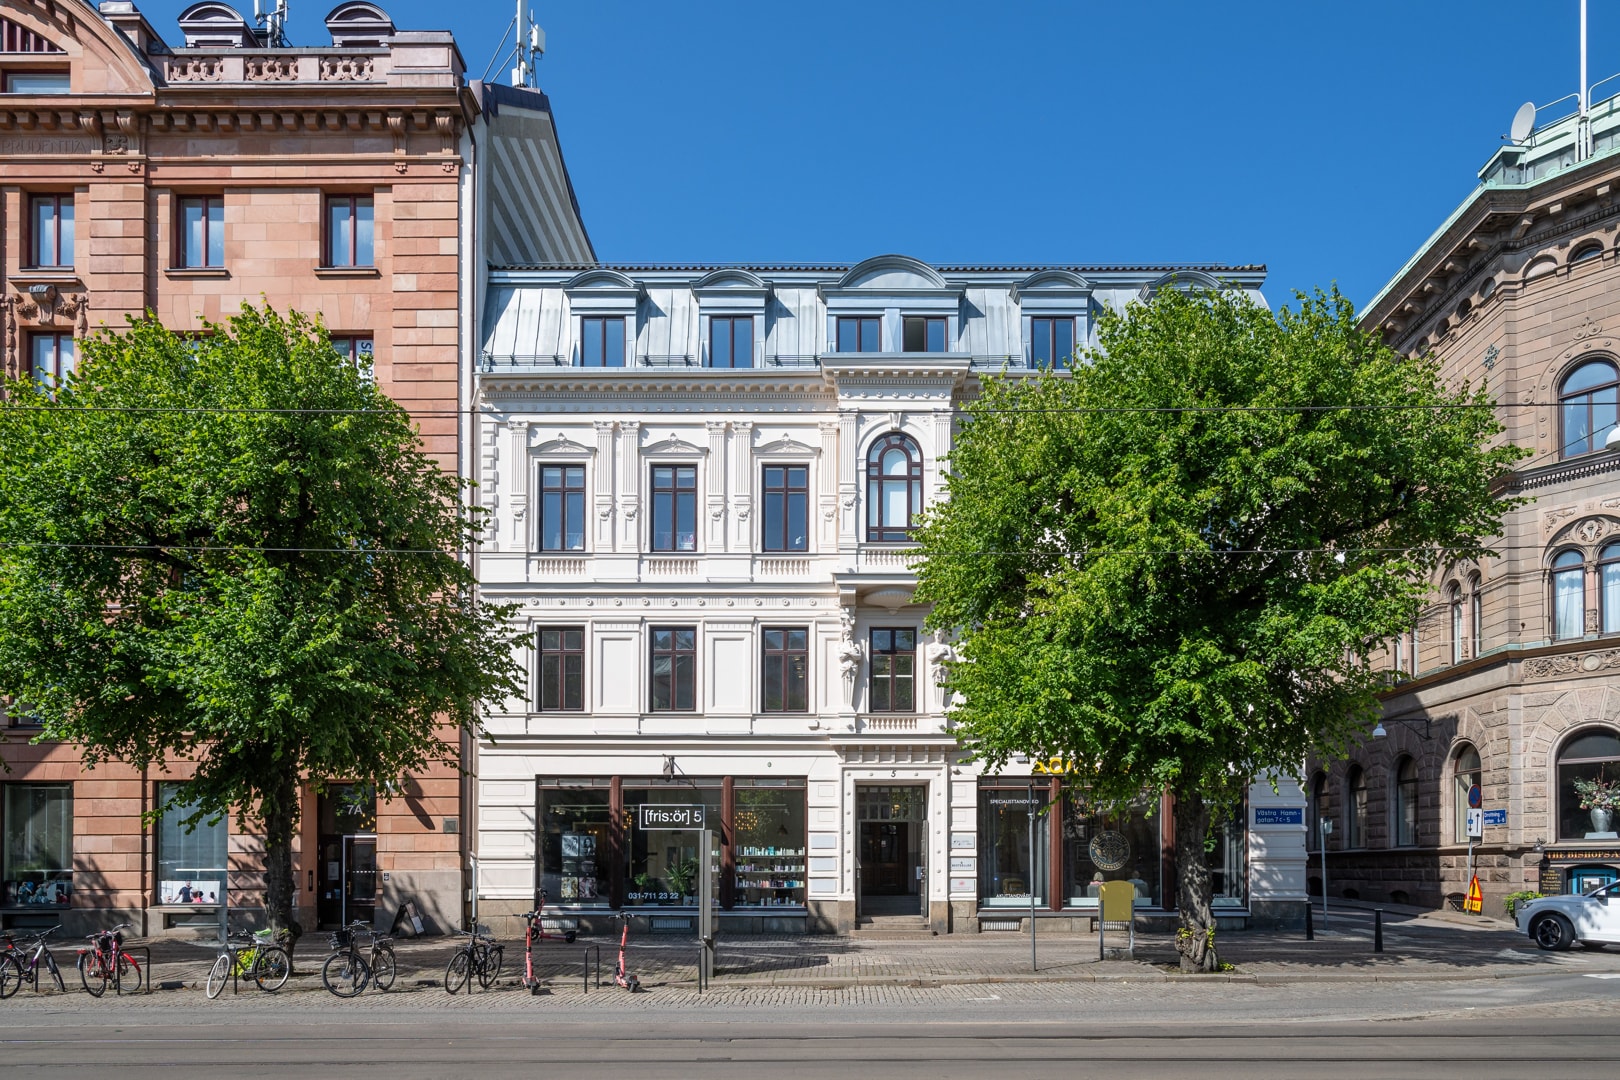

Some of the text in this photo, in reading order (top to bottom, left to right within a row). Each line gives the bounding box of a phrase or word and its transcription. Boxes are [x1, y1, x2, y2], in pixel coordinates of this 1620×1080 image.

[1, 138, 88, 154] PRUDENTIA
[346, 804, 363, 815] 7A
[645, 809, 702, 825] [fris:ör] 5
[1547, 851, 1566, 859] THE
